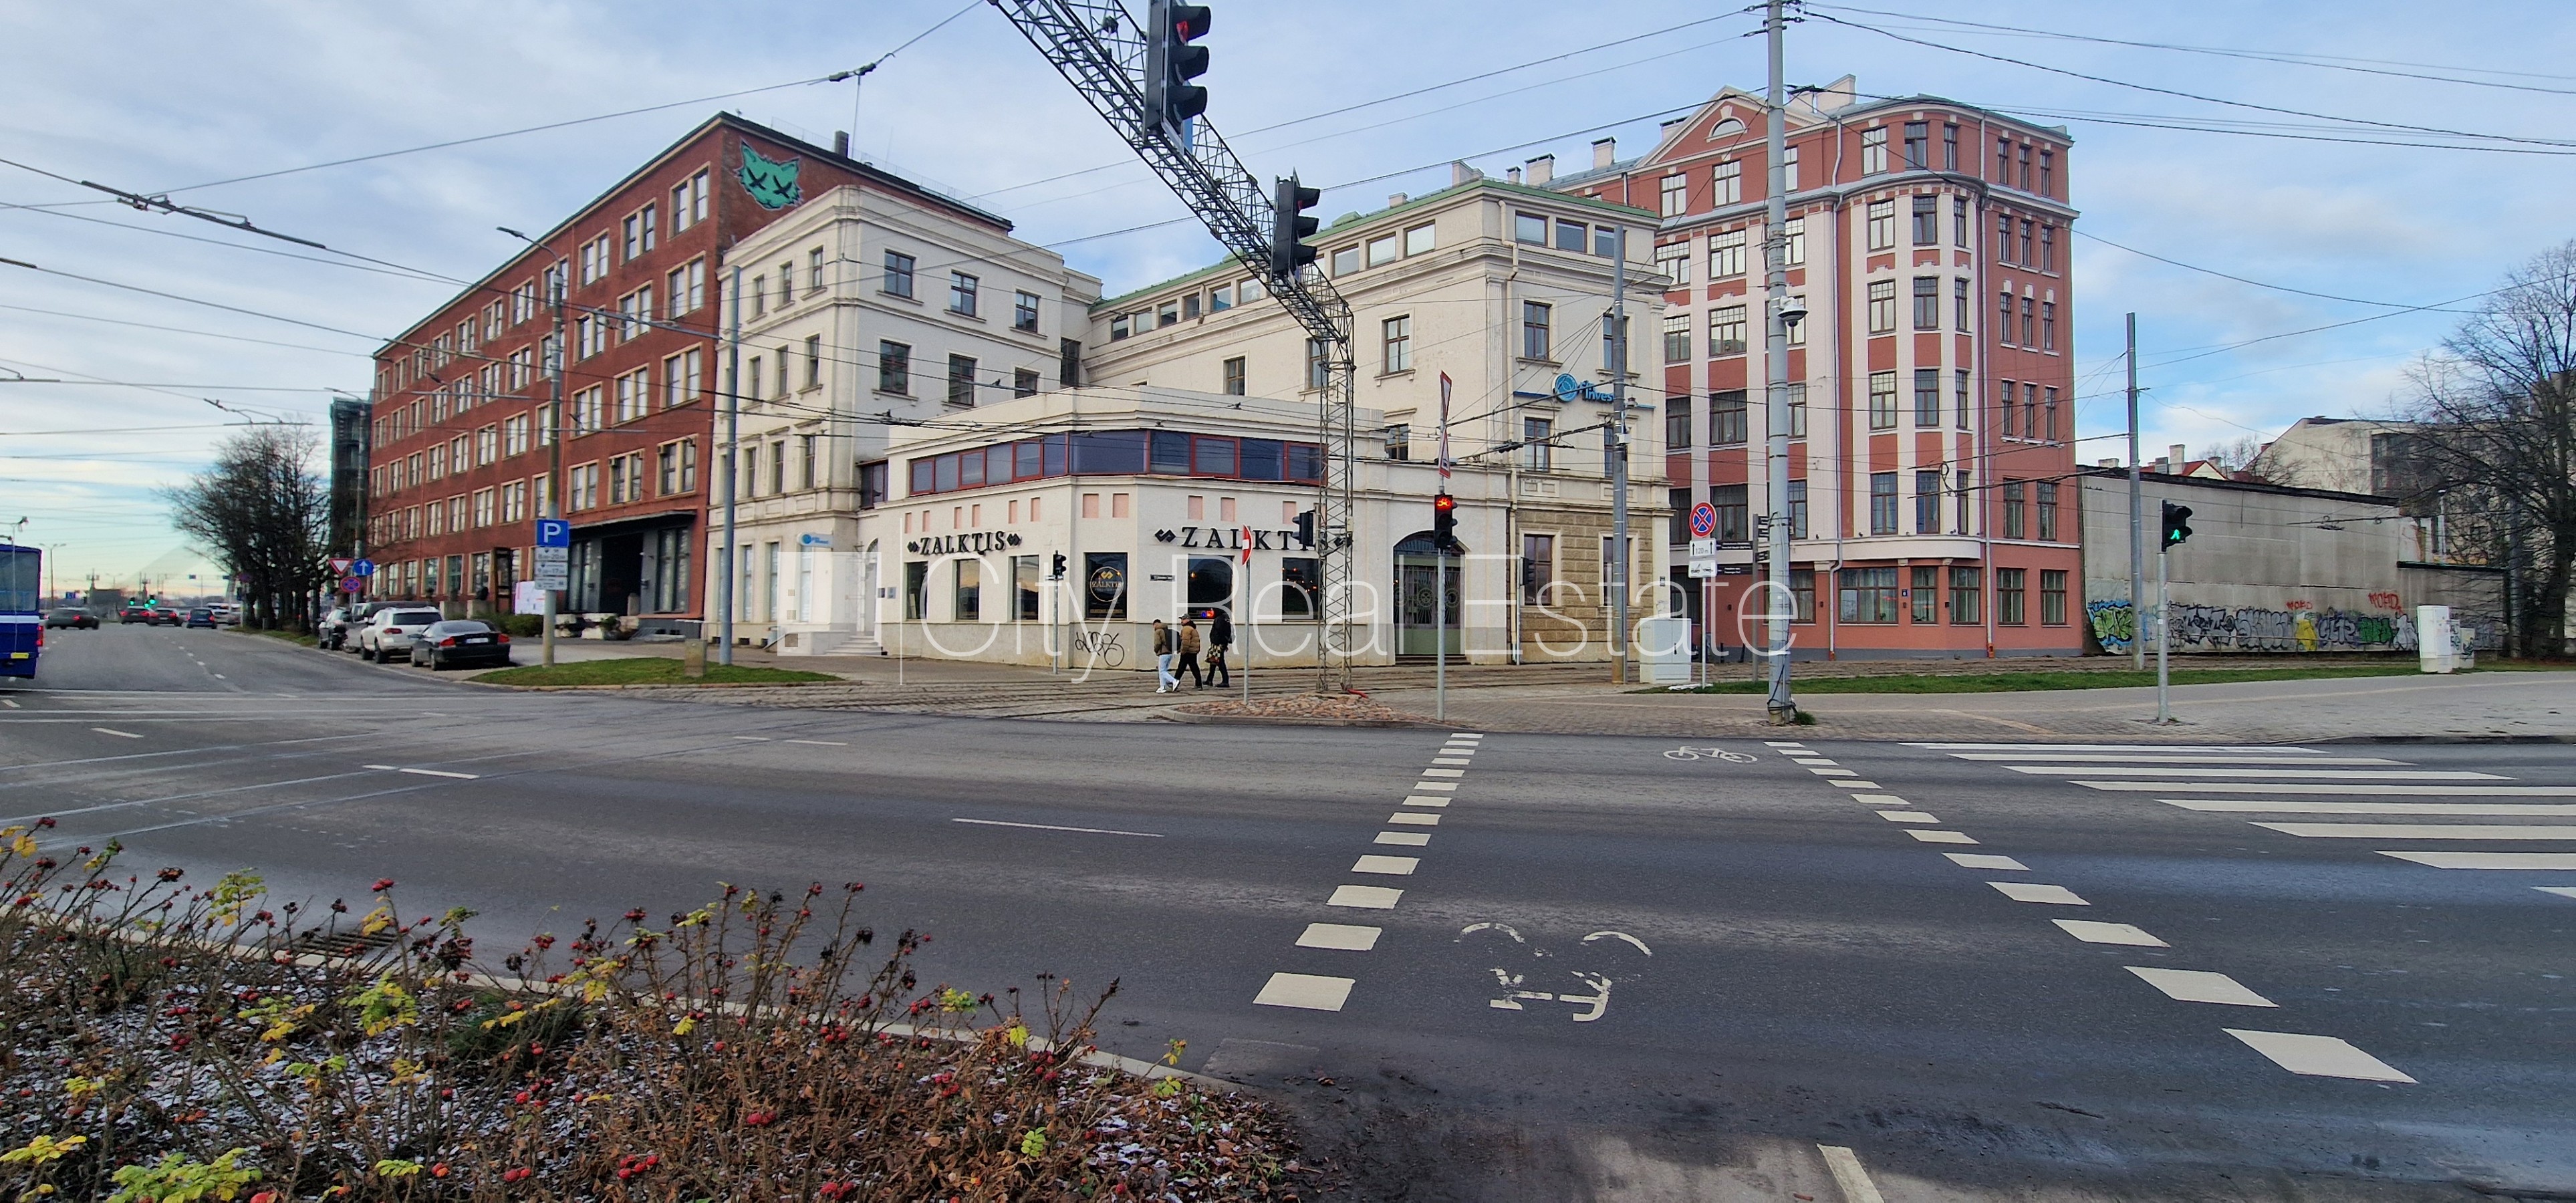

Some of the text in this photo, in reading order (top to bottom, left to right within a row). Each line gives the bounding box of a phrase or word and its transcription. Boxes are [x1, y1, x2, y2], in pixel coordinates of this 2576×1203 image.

[1585, 388, 1614, 402] Inves
[543, 523, 561, 543] P
[920, 531, 1005, 555] ZALKTIS
